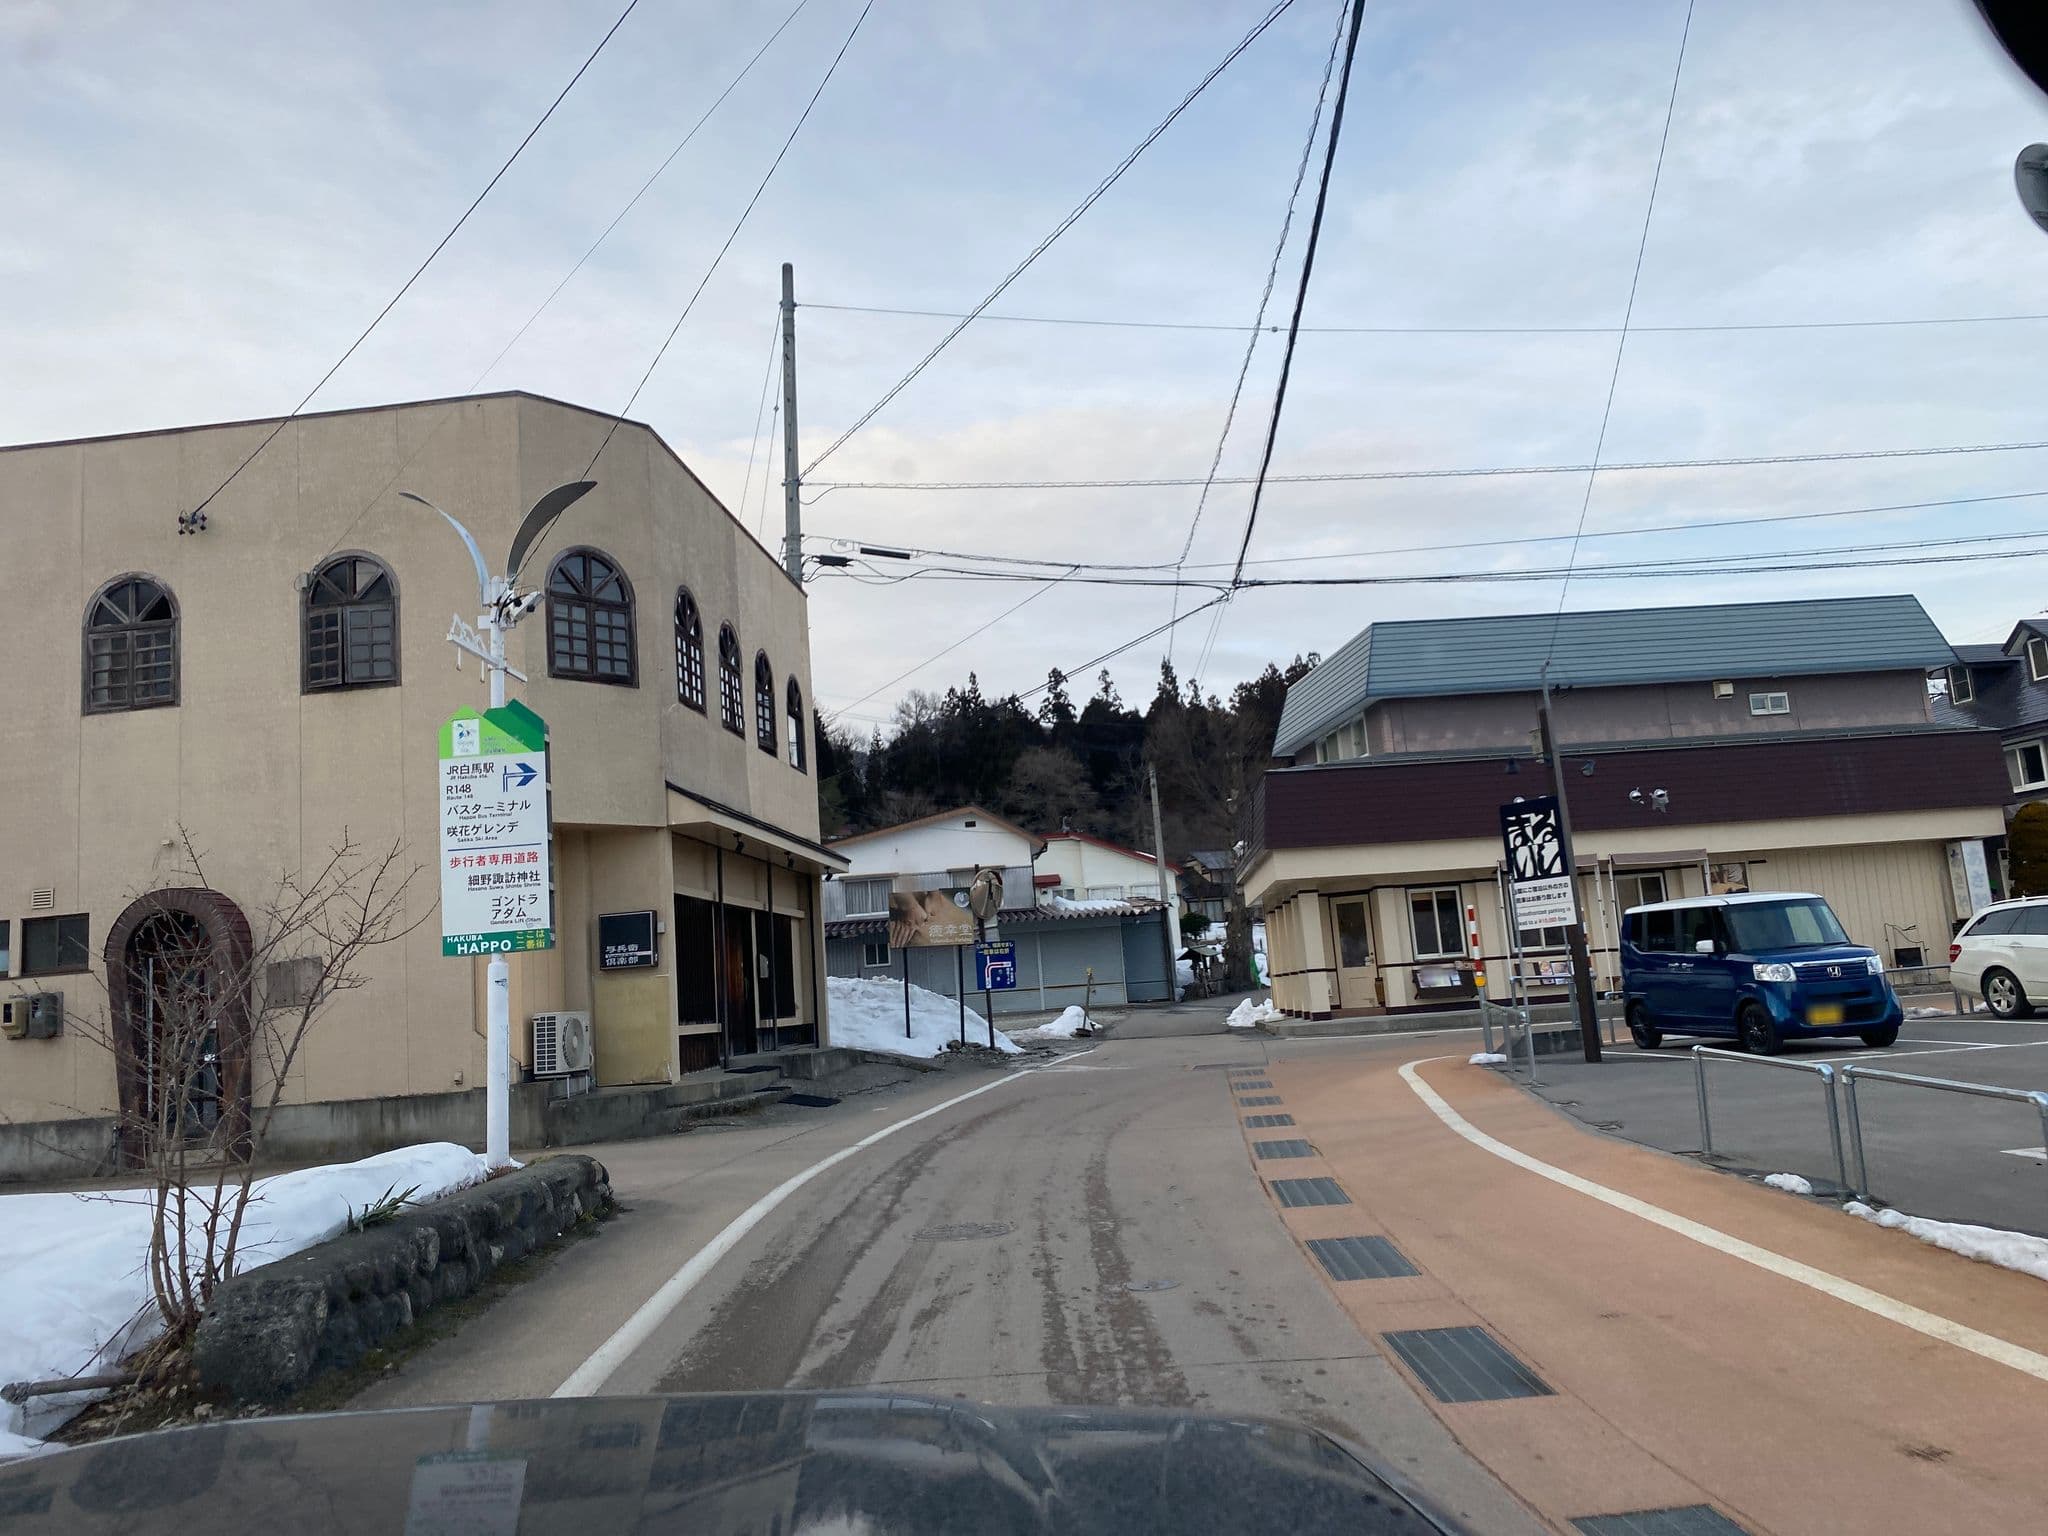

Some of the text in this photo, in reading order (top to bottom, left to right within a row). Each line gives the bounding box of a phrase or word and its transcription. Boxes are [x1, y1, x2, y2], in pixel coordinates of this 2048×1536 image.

[446, 762, 494, 775] JR白馬駅
[446, 783, 472, 794] R148
[447, 799, 531, 816] バスターミナル
[446, 820, 519, 838] 咲花ゲレンデ
[449, 851, 539, 870] 歩行者専用道路
[467, 870, 541, 886] 細野諏訪神社
[491, 893, 538, 907] ゴンドラ
[491, 907, 527, 920] アダム
[446, 934, 483, 943] HAKUBA
[516, 928, 545, 939] ここは
[457, 939, 512, 955] HAPPO
